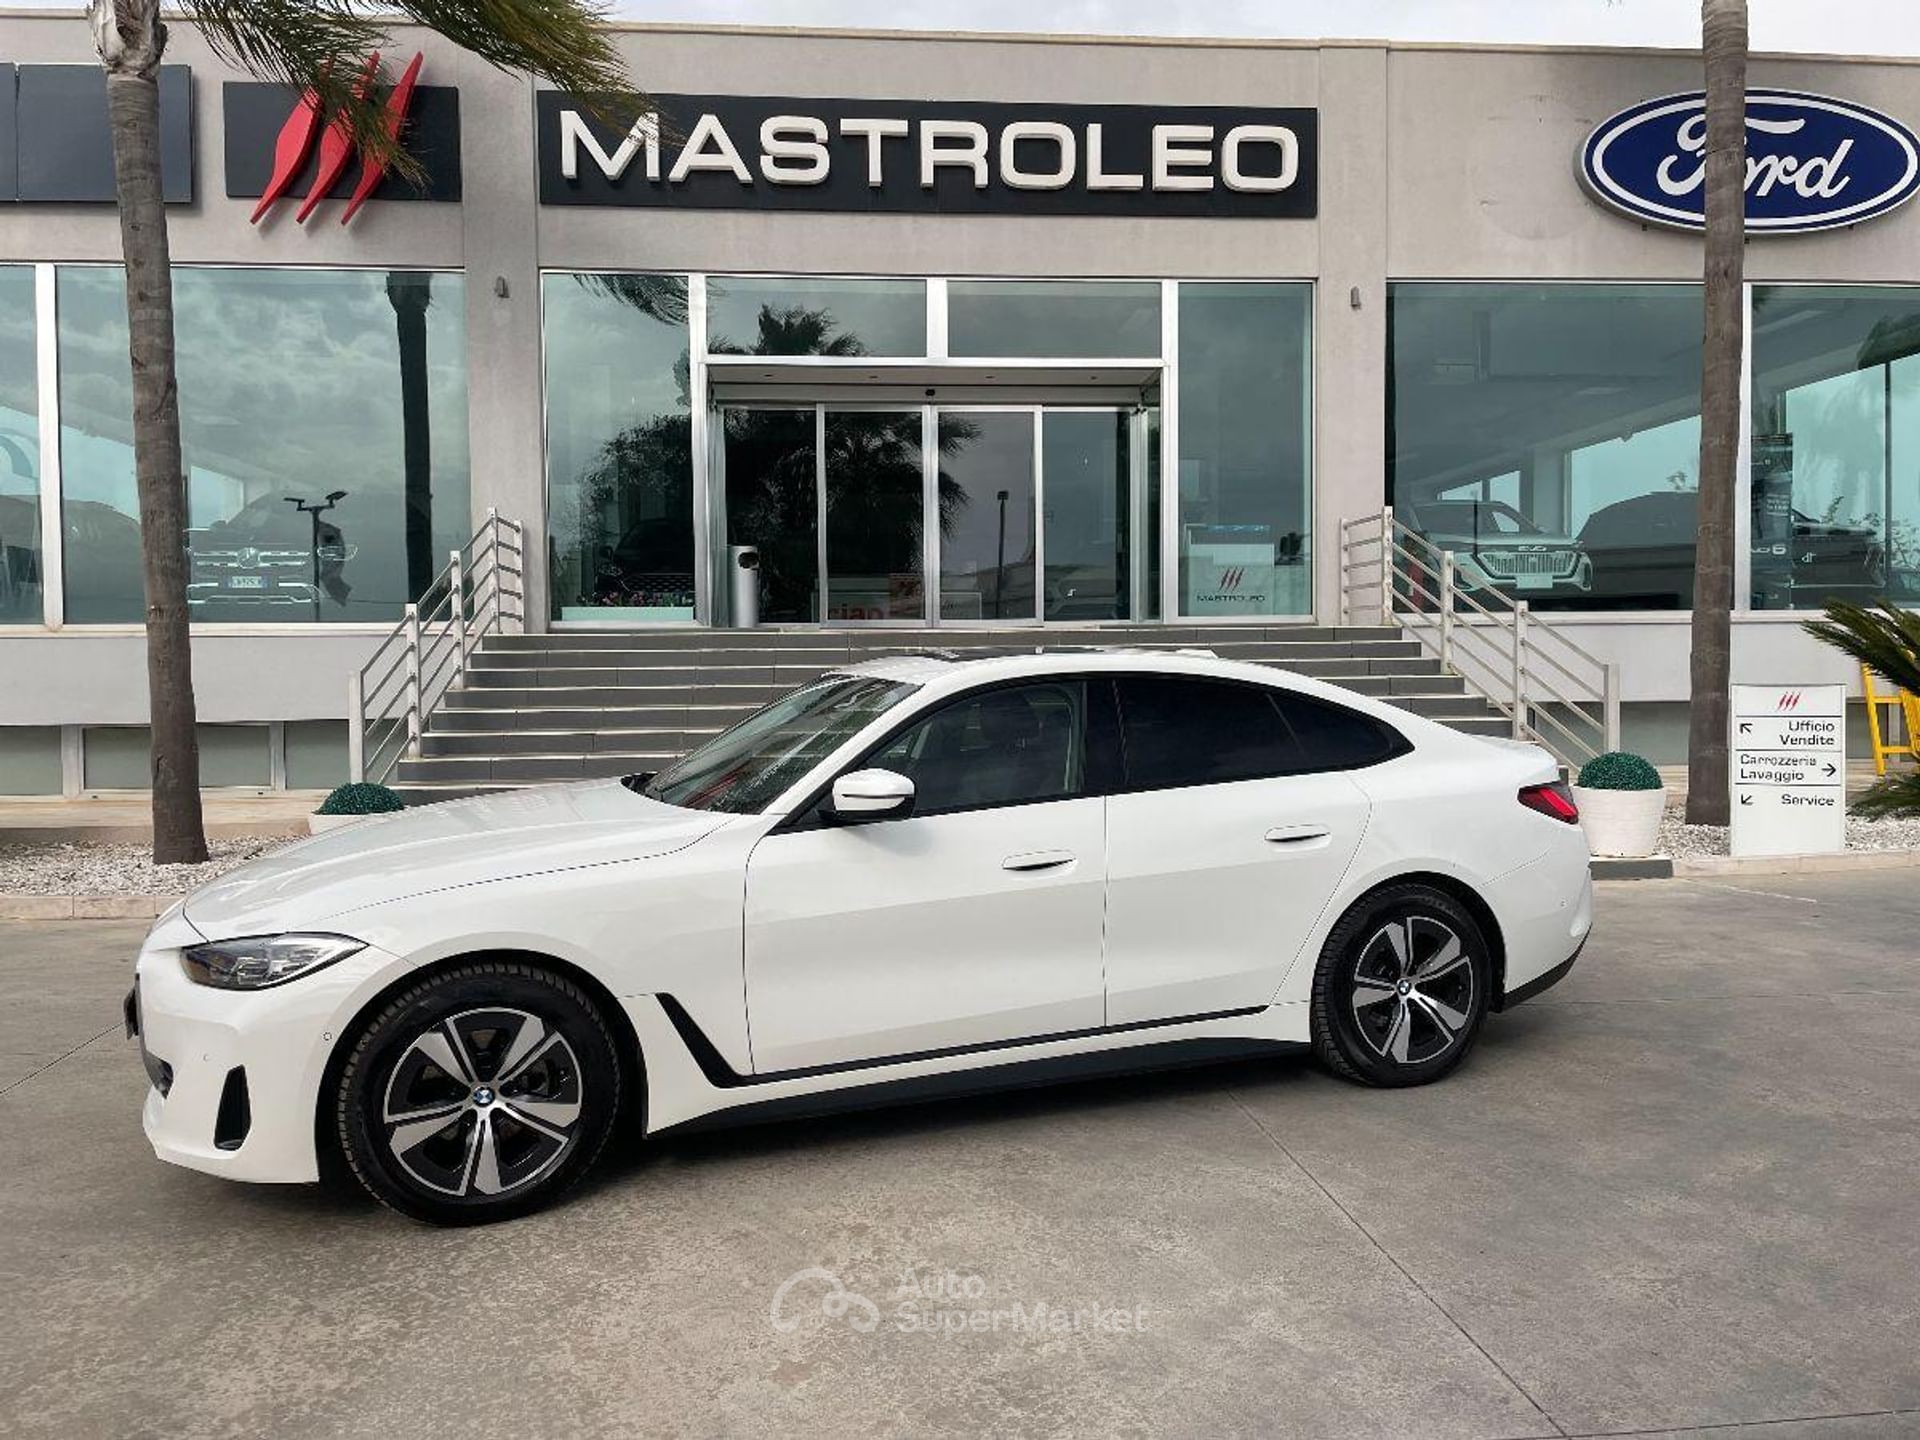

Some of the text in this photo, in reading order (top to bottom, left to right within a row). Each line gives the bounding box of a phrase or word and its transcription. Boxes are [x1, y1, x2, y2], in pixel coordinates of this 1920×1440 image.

[560, 109, 1299, 191] MASTROLEO
[1656, 113, 1854, 198] Frd
[1788, 720, 1835, 732] Ufficio
[1779, 734, 1835, 746] Vendite
[1740, 753, 1817, 767] Carrozzeria
[1740, 768, 1804, 783] Lavaggio
[1781, 793, 1835, 806] Service
